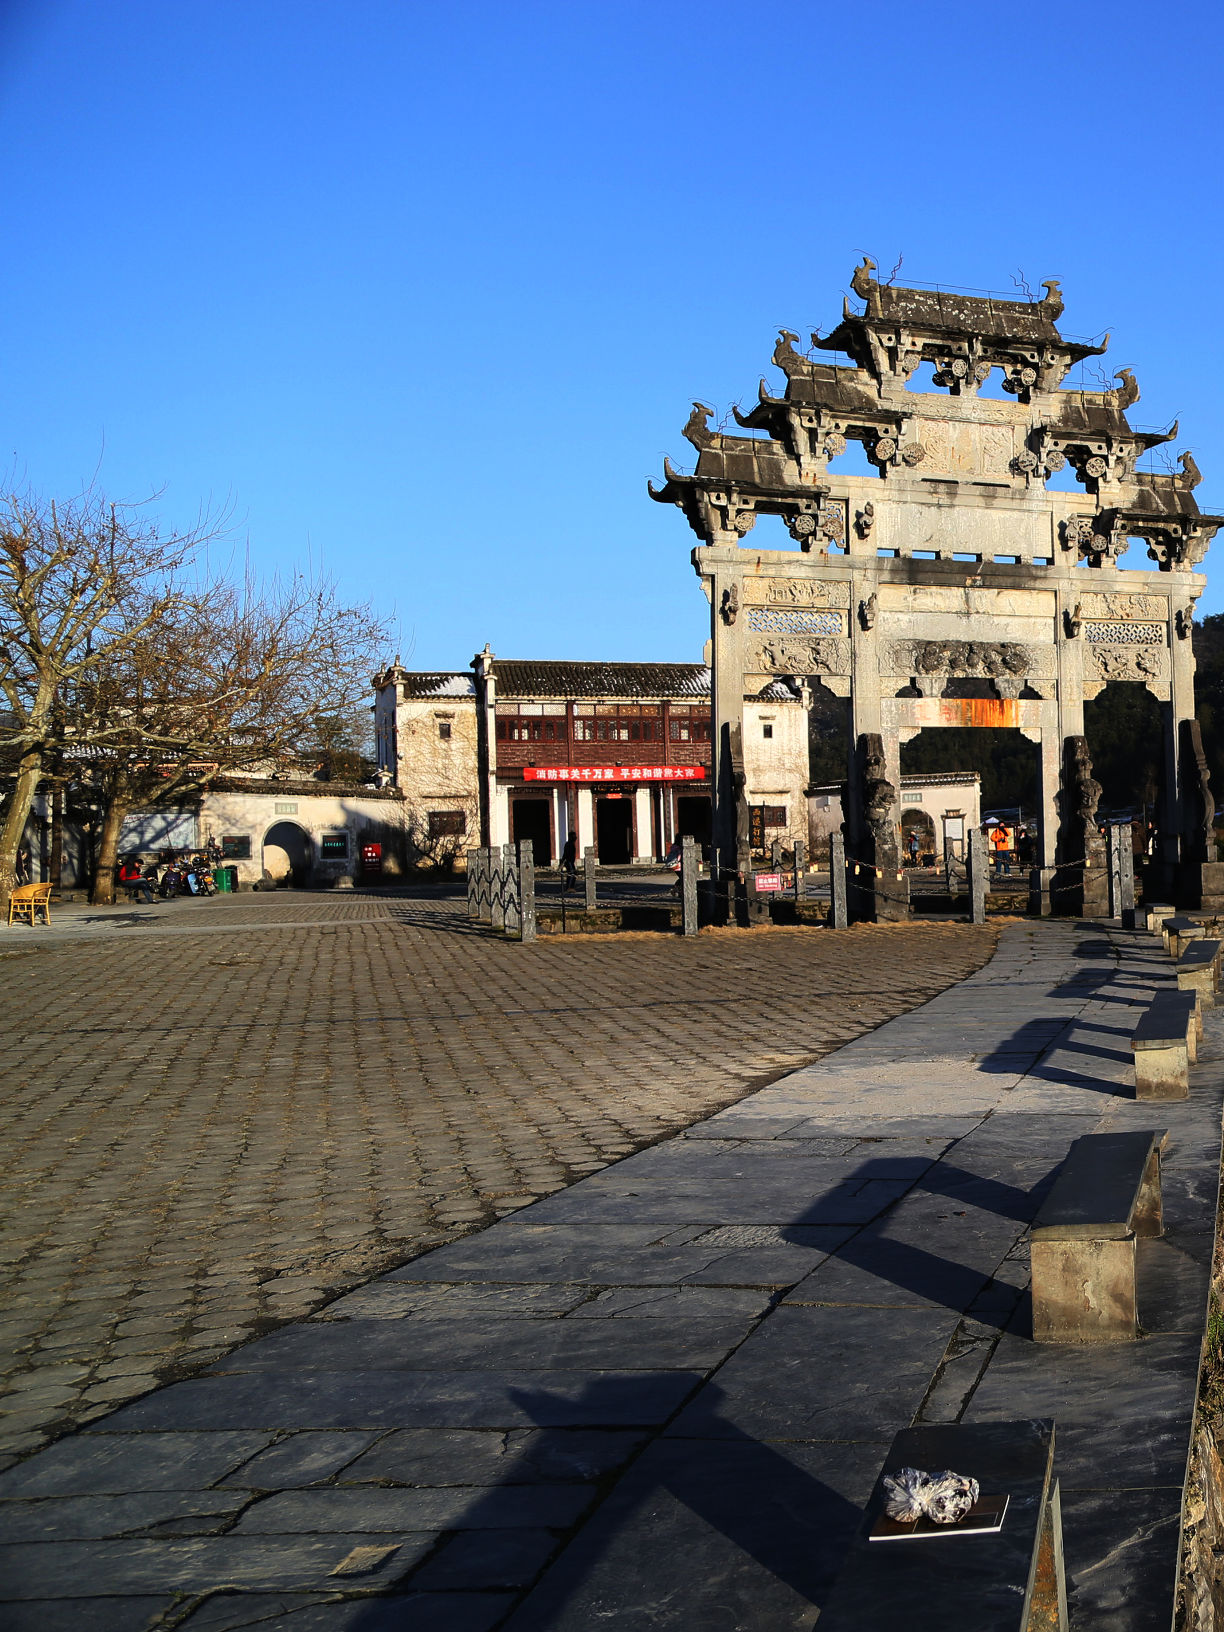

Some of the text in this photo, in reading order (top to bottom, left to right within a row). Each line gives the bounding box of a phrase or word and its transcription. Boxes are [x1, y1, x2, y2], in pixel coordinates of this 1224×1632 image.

[536, 768, 614, 779] 消防事关千万家
